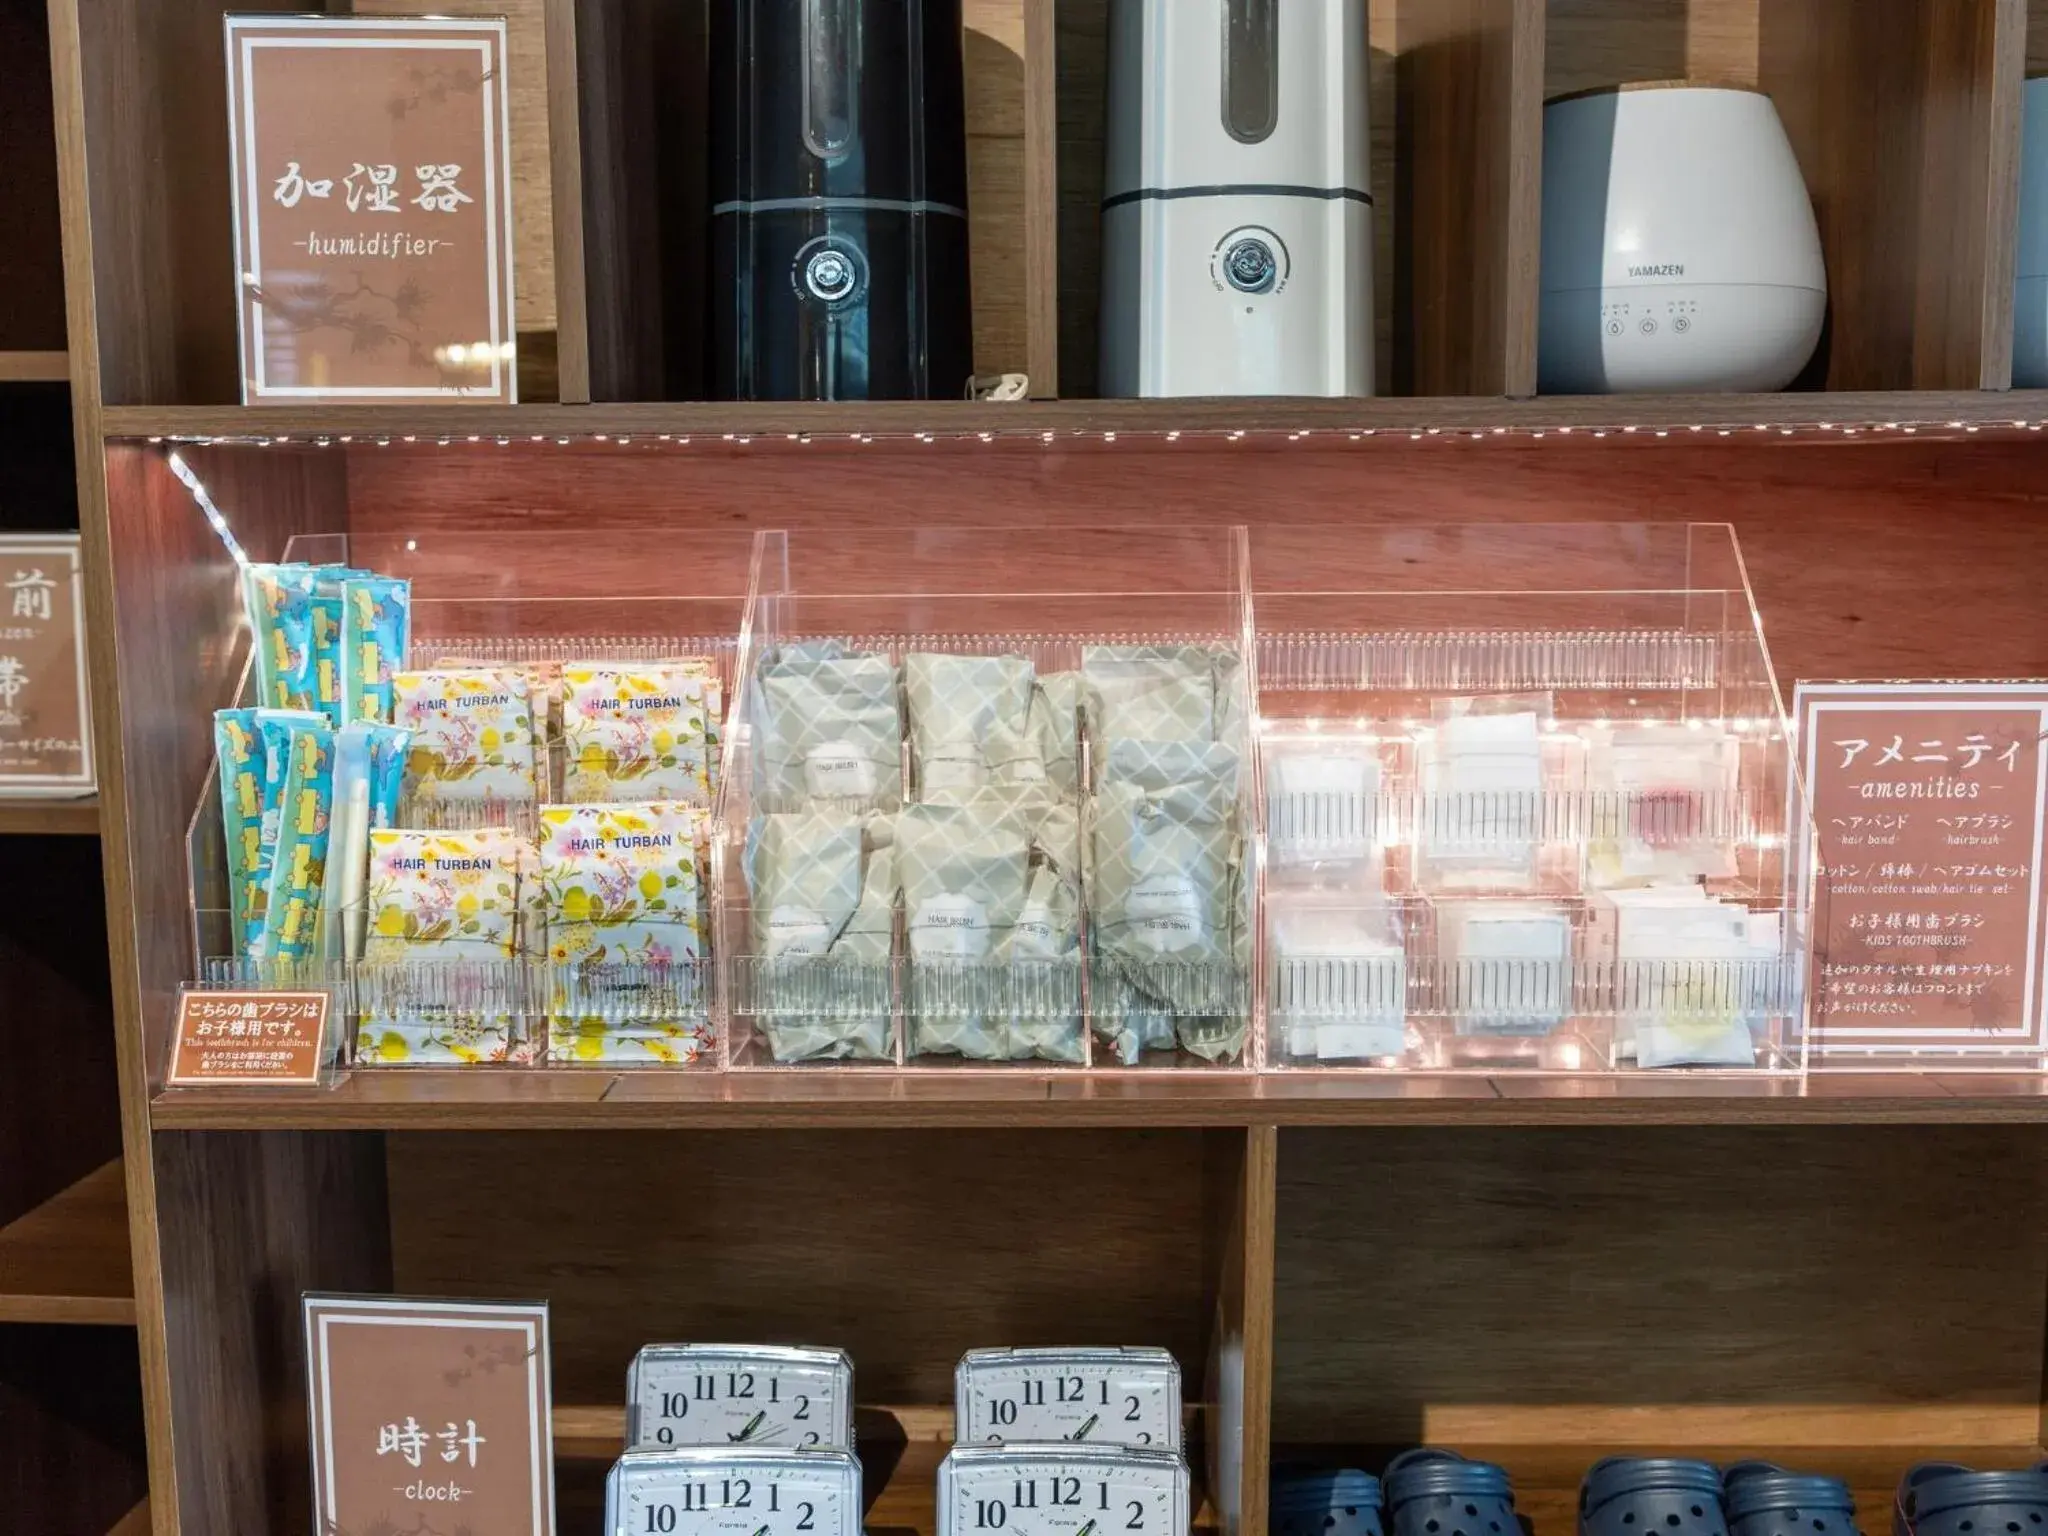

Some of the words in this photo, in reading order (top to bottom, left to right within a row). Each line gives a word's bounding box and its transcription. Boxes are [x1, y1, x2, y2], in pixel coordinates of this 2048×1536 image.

[274, 161, 475, 213] 加湿器
[1628, 264, 1685, 277] YAMAZEN
[5, 568, 58, 620] 前
[416, 699, 449, 712] HAIR
[455, 694, 509, 709] TURBAN
[591, 698, 621, 711] HAIR
[628, 697, 682, 710] TURBAN
[1832, 734, 2022, 773] アメニティ
[1831, 813, 1910, 830] ヘアバンド
[1936, 811, 2013, 830] ヘアブラシ
[570, 838, 606, 851] HAIR
[613, 834, 672, 850] TURBAN
[393, 857, 427, 871] HAIR
[433, 857, 492, 872] TURBAN
[1848, 911, 1986, 930] お子様用歯ブラシ
[187, 1001, 319, 1018] こちらの歯ブラシは
[196, 1019, 305, 1037] お子様用です。
[692, 1374, 716, 1401] 11
[726, 1372, 755, 1399] 12
[768, 1377, 780, 1403] 1
[1022, 1380, 1047, 1406] 11
[1055, 1376, 1085, 1402] 12
[1099, 1379, 1111, 1406] 1
[660, 1392, 689, 1419] 10
[793, 1394, 810, 1421] 2
[987, 1399, 1018, 1426] 10
[1124, 1396, 1141, 1422] 2
[682, 1483, 710, 1512] 11
[720, 1479, 752, 1508] 12
[767, 1483, 782, 1513] 1
[1011, 1479, 1040, 1509] 11
[1049, 1476, 1082, 1506] 12
[1096, 1481, 1111, 1511] 1
[645, 1504, 677, 1533] 10
[796, 1502, 815, 1531] 2
[974, 1499, 1007, 1529] 10
[1125, 1501, 1145, 1530] 2
